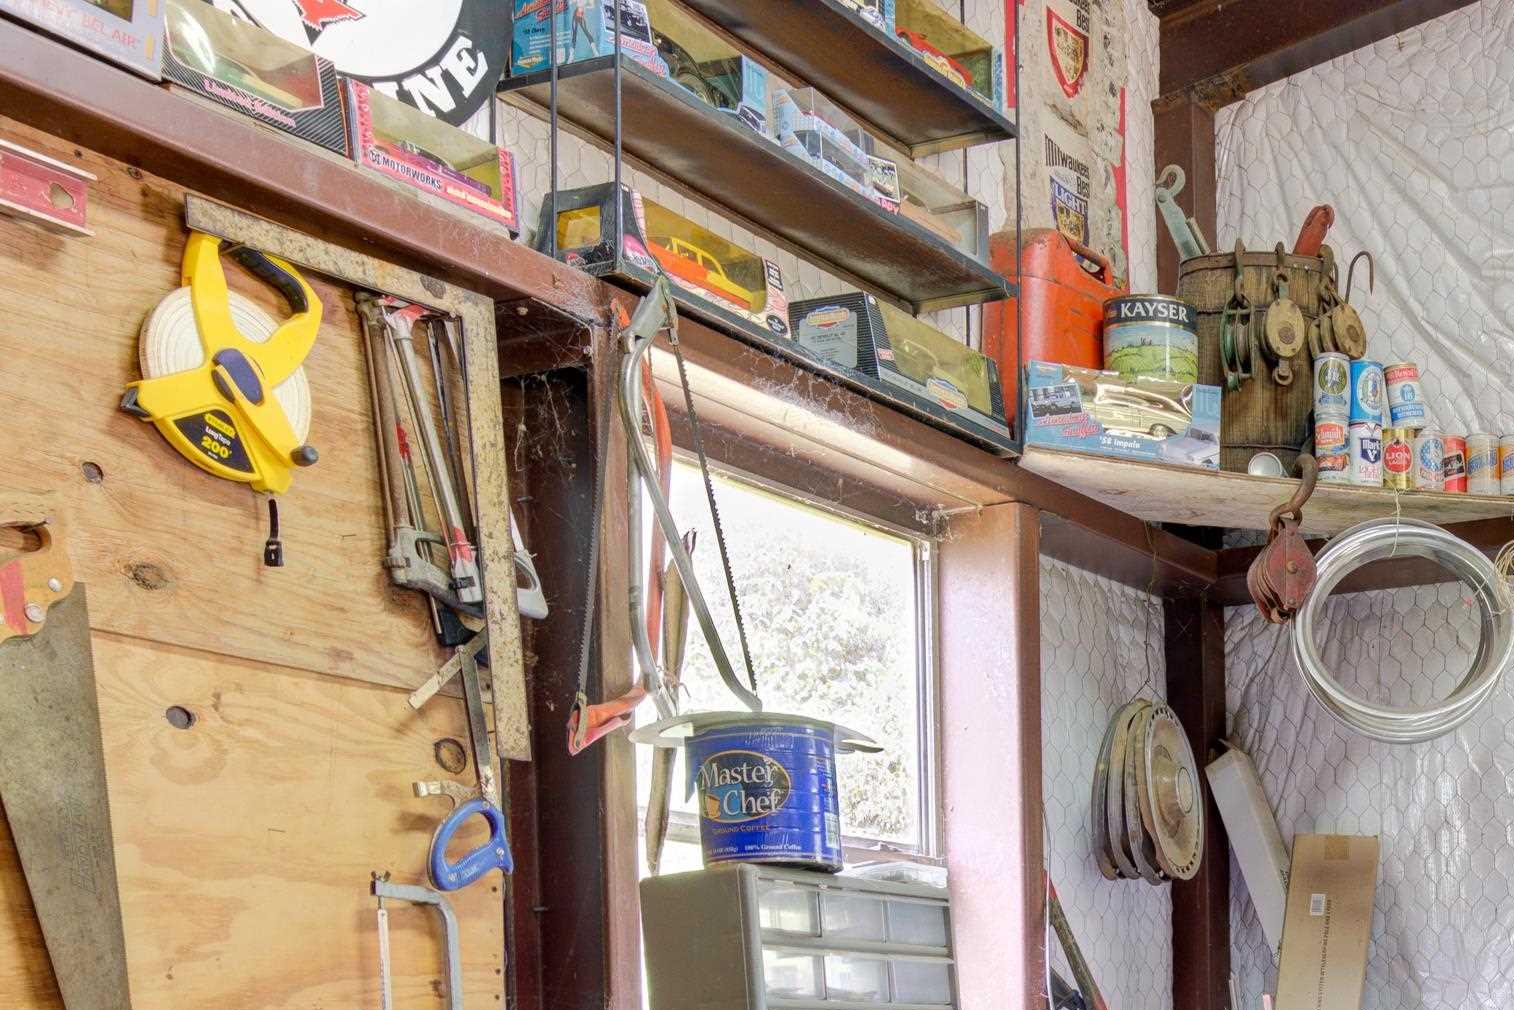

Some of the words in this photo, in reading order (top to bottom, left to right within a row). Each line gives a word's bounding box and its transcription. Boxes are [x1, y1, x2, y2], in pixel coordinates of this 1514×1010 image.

[1076, 9, 1090, 33] Bes
[382, 156, 442, 190] MOTORWORKS
[1055, 183, 1088, 213] LIGHT
[1120, 302, 1189, 323] KAYSER
[698, 760, 778, 790] Master
[723, 789, 784, 817] Chef
